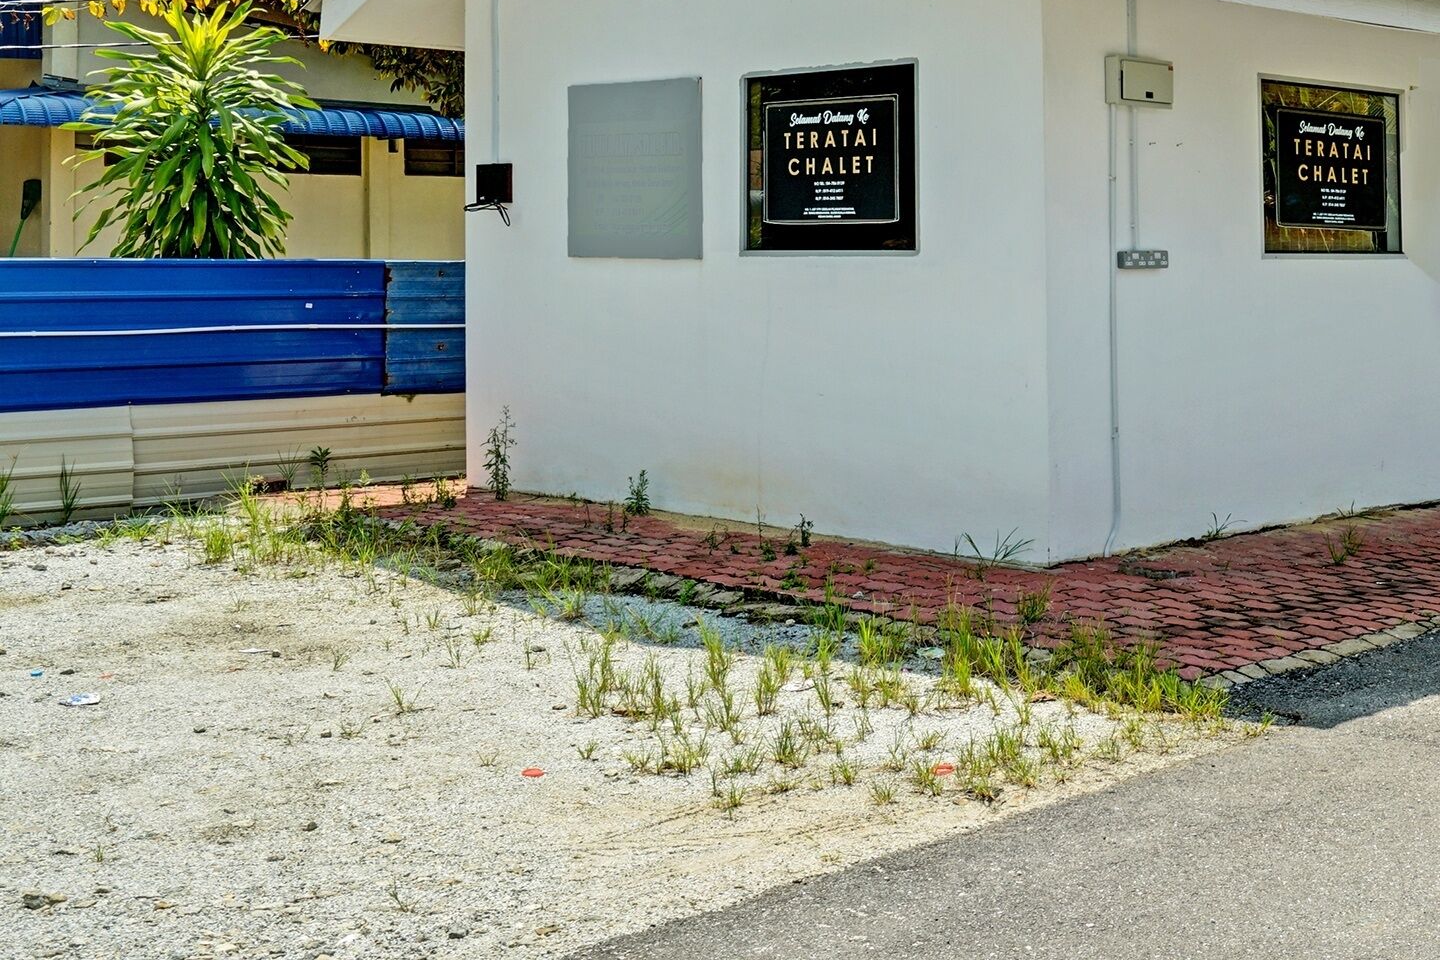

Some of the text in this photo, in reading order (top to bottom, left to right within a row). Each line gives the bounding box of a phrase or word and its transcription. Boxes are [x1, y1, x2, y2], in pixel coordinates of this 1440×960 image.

[789, 108, 869, 127] Selamat Datang Ke
[784, 128, 876, 149] TERATAI
[1299, 120, 1365, 140] Selamat Datang Ke
[1294, 138, 1370, 160] TERATAI
[788, 156, 873, 175] CHALET
[1298, 164, 1368, 184] CHALET
